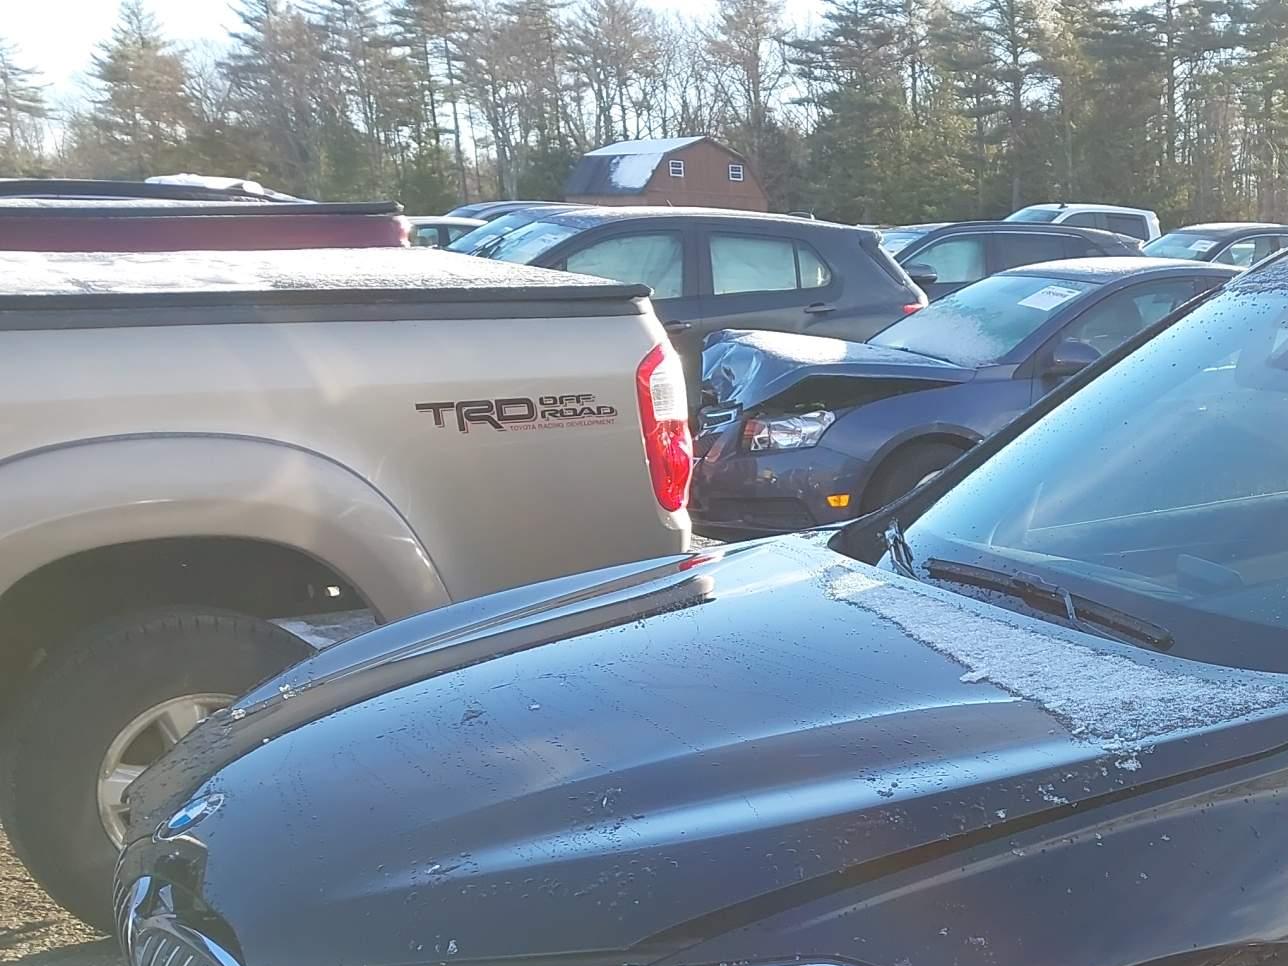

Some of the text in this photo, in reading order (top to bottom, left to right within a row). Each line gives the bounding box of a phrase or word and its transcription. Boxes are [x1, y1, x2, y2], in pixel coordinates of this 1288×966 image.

[538, 394, 597, 406] OFF
[415, 398, 537, 433] TRD
[541, 405, 618, 420] ROAD
